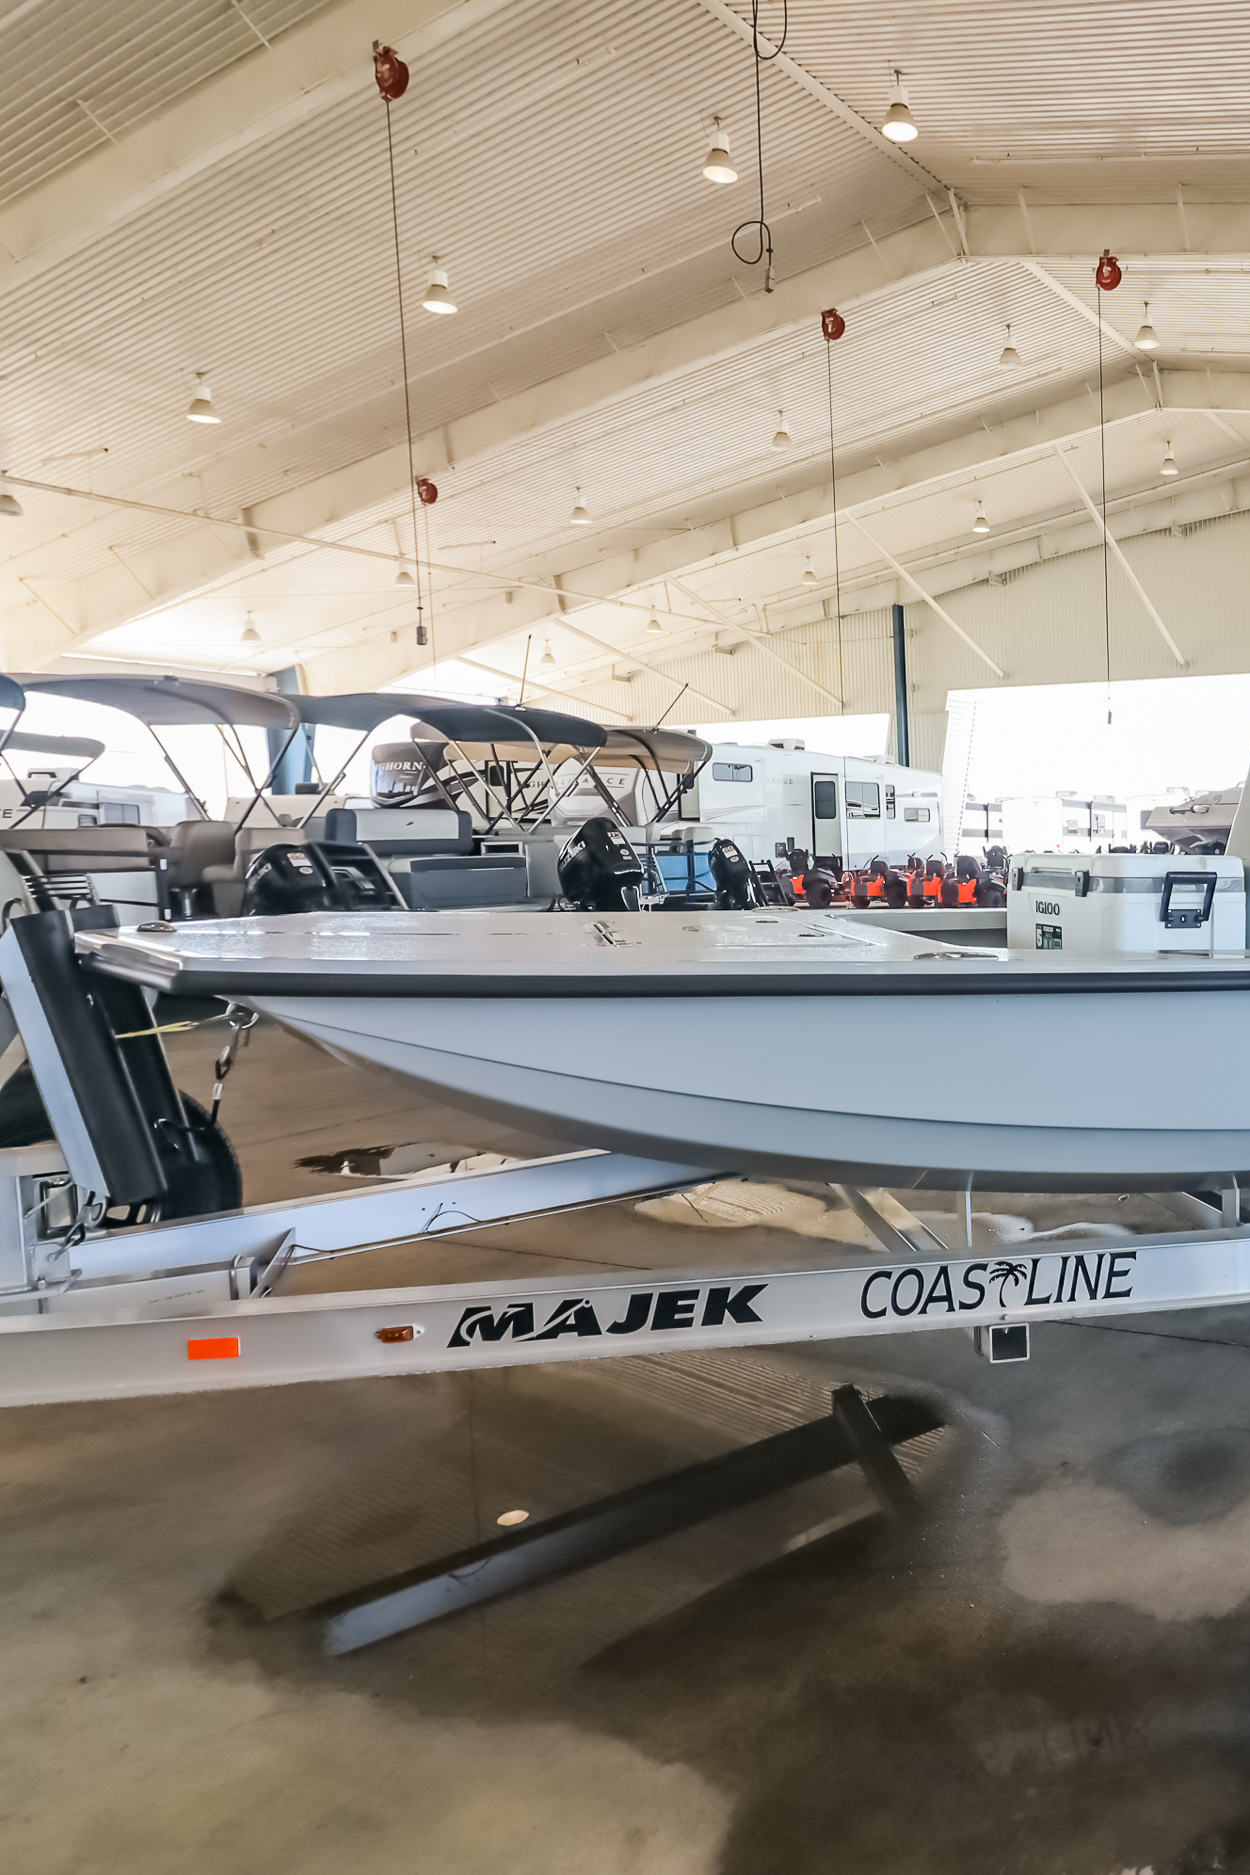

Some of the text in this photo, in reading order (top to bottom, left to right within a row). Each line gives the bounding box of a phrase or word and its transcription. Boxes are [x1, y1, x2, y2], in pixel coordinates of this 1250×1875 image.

[378, 761, 424, 771] GHORN
[560, 840, 587, 871] UZUKI
[1036, 901, 1060, 915] IGLOO
[446, 1284, 769, 1349] MAJEK
